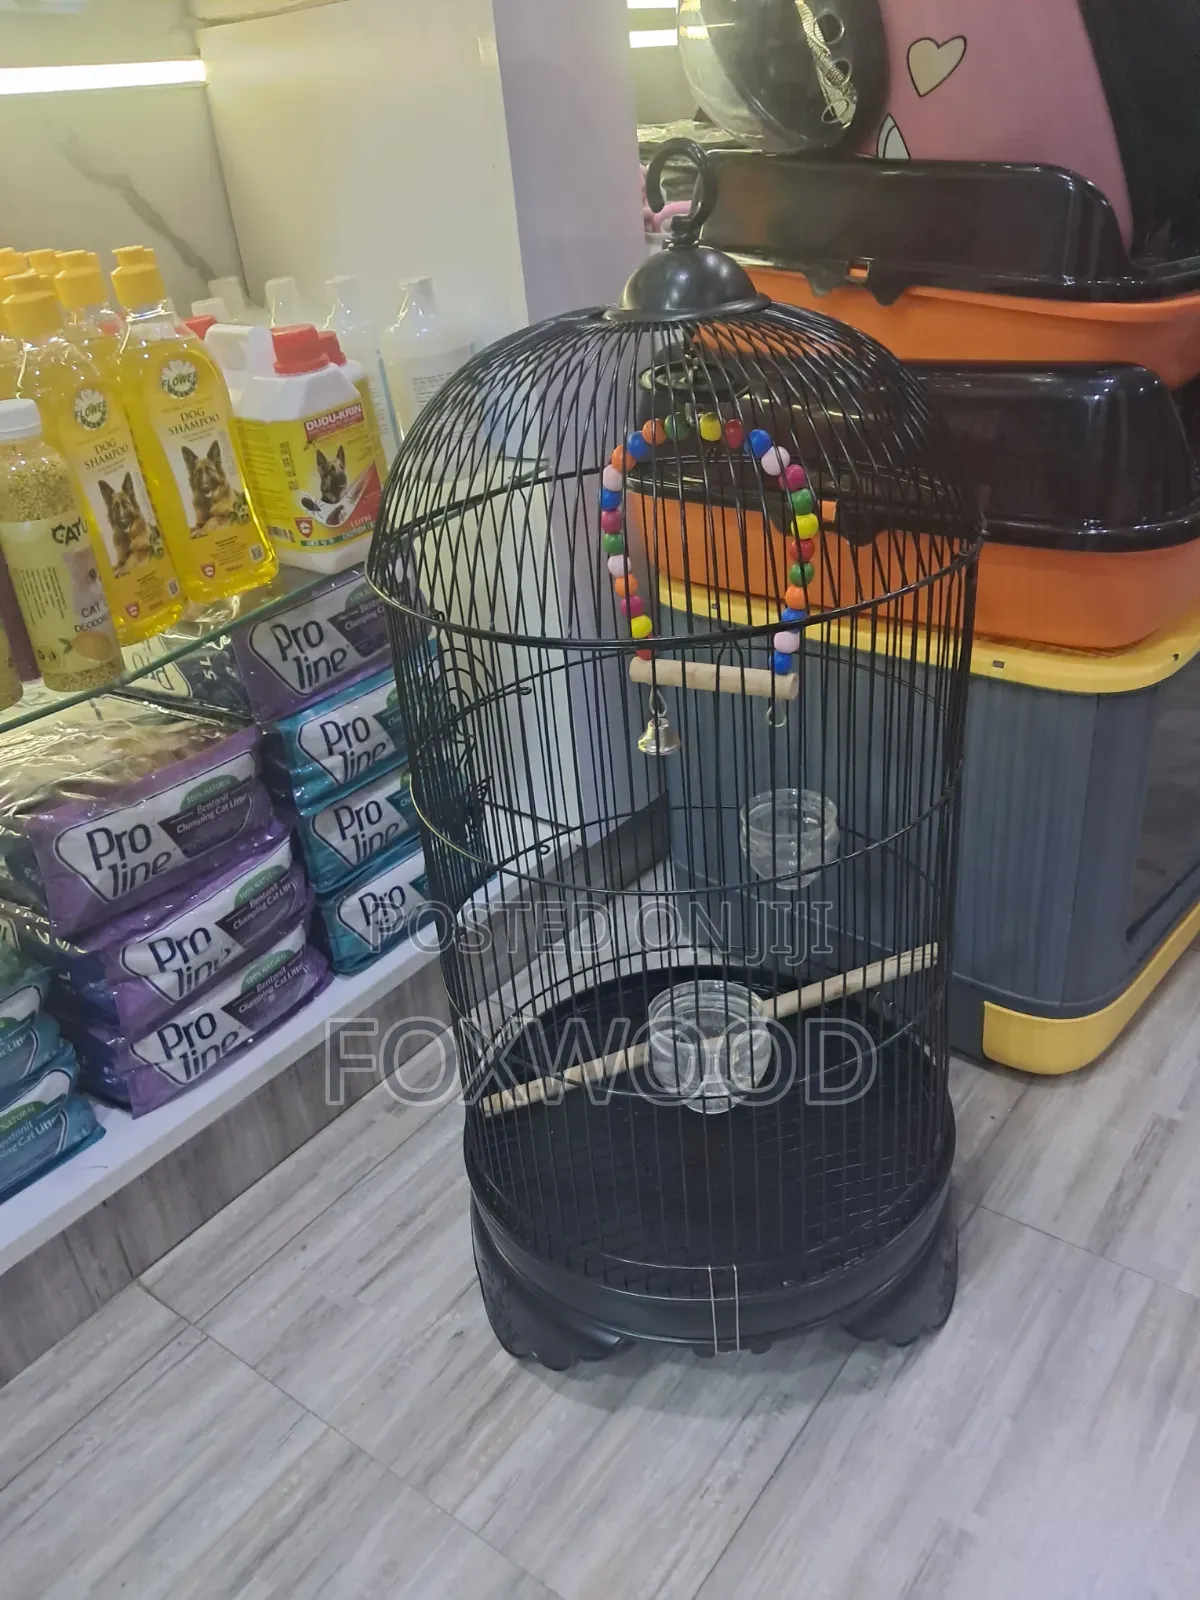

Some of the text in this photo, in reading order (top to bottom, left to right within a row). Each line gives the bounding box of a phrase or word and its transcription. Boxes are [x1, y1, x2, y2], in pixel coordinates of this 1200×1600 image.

[162, 371, 198, 390] FLOWER
[168, 413, 220, 436] SHAMPOO
[180, 407, 205, 422] DOG
[83, 444, 129, 470] SHAMPOO
[94, 438, 117, 454] DOG
[81, 602, 101, 618] CAT
[270, 620, 324, 662] Pro
[292, 647, 348, 690] line
[319, 716, 371, 757] Pro
[176, 810, 215, 833] Clumping
[215, 801, 229, 815] Cat
[333, 800, 383, 841] Pro
[86, 823, 152, 871] Pro
[107, 851, 172, 898] line
[233, 902, 267, 930] Clumping
[267, 891, 280, 905] Cat
[358, 885, 406, 927] Pro
[148, 926, 212, 973] Pro
[274, 975, 287, 988] Cat
[156, 1012, 217, 1061] Pro
[178, 1030, 239, 1080] line
